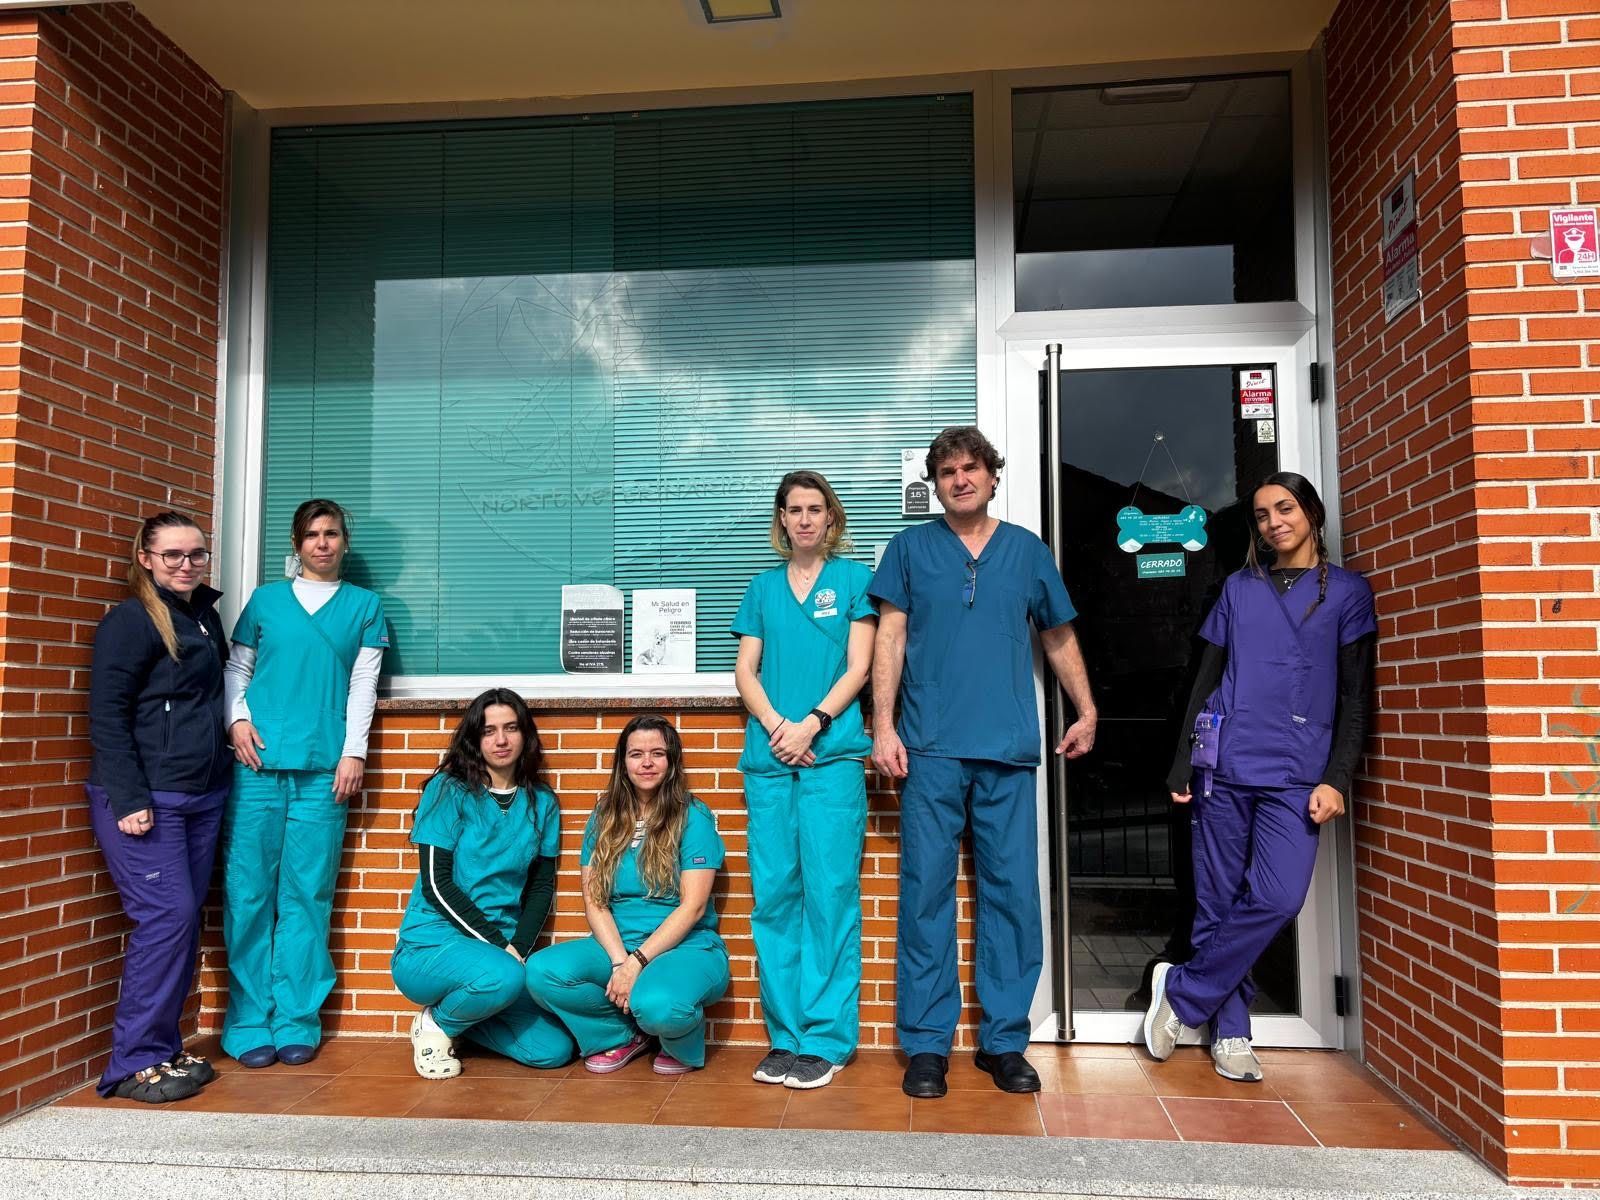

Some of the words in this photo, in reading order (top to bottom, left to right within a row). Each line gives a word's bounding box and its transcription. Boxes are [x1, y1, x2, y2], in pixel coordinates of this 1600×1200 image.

[1553, 214, 1594, 224] Vigilante
[1386, 232, 1415, 266] Alarma
[573, 479, 762, 506] VEERINARIOS
[1140, 559, 1182, 568] CERRADO
